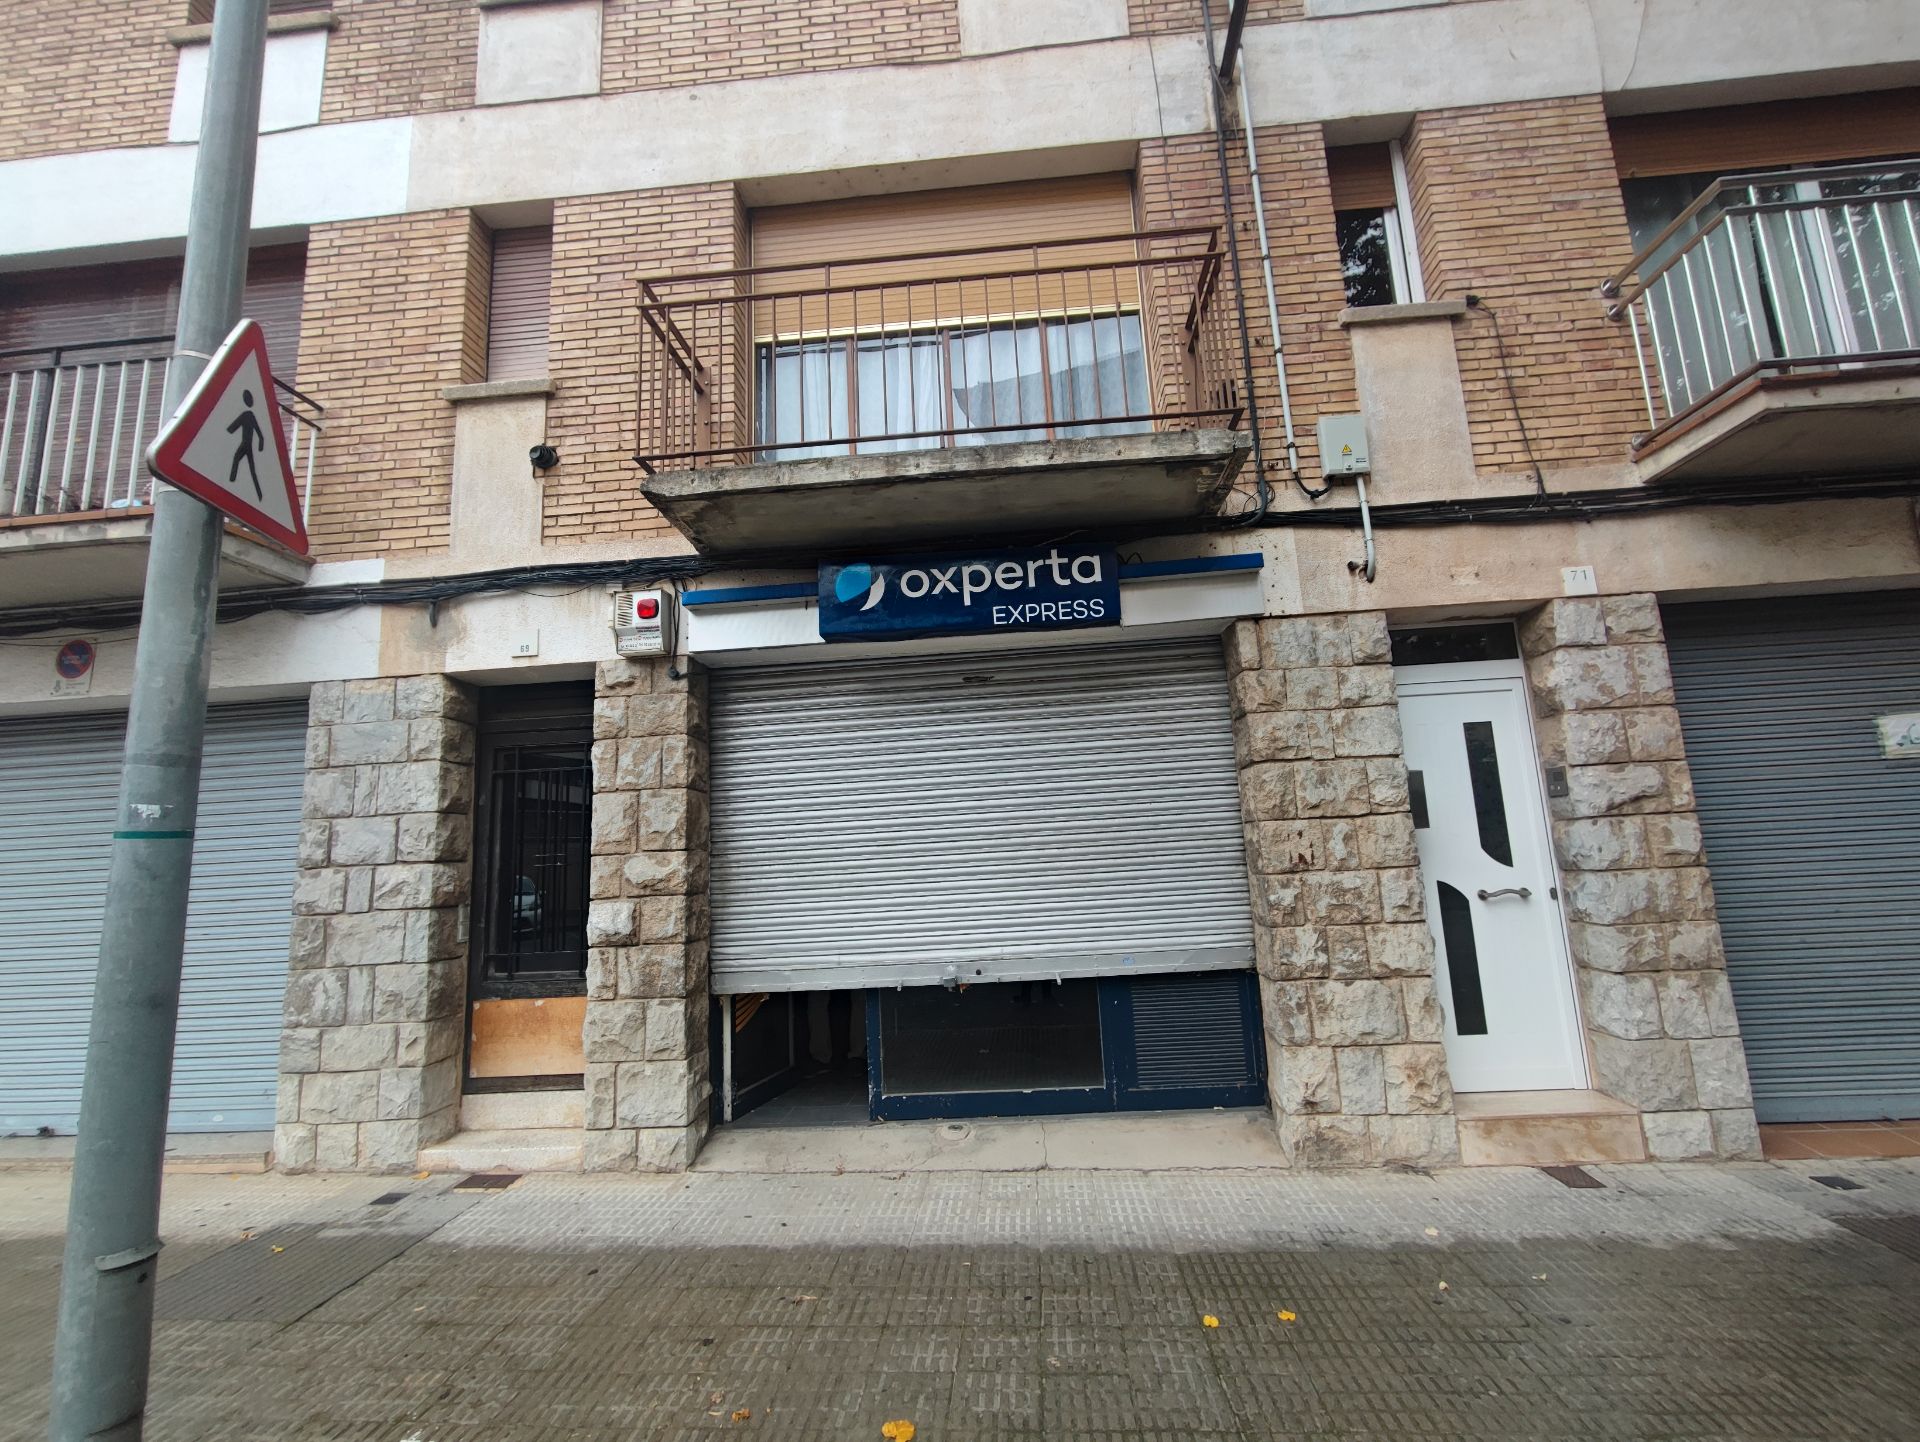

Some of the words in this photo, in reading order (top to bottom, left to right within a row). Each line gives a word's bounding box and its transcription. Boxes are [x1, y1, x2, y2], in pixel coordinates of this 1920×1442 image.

[900, 549, 1103, 607] oxperta
[1569, 569, 1587, 581] 71
[992, 598, 1105, 625] EXPRESS
[520, 644, 530, 653] 69
